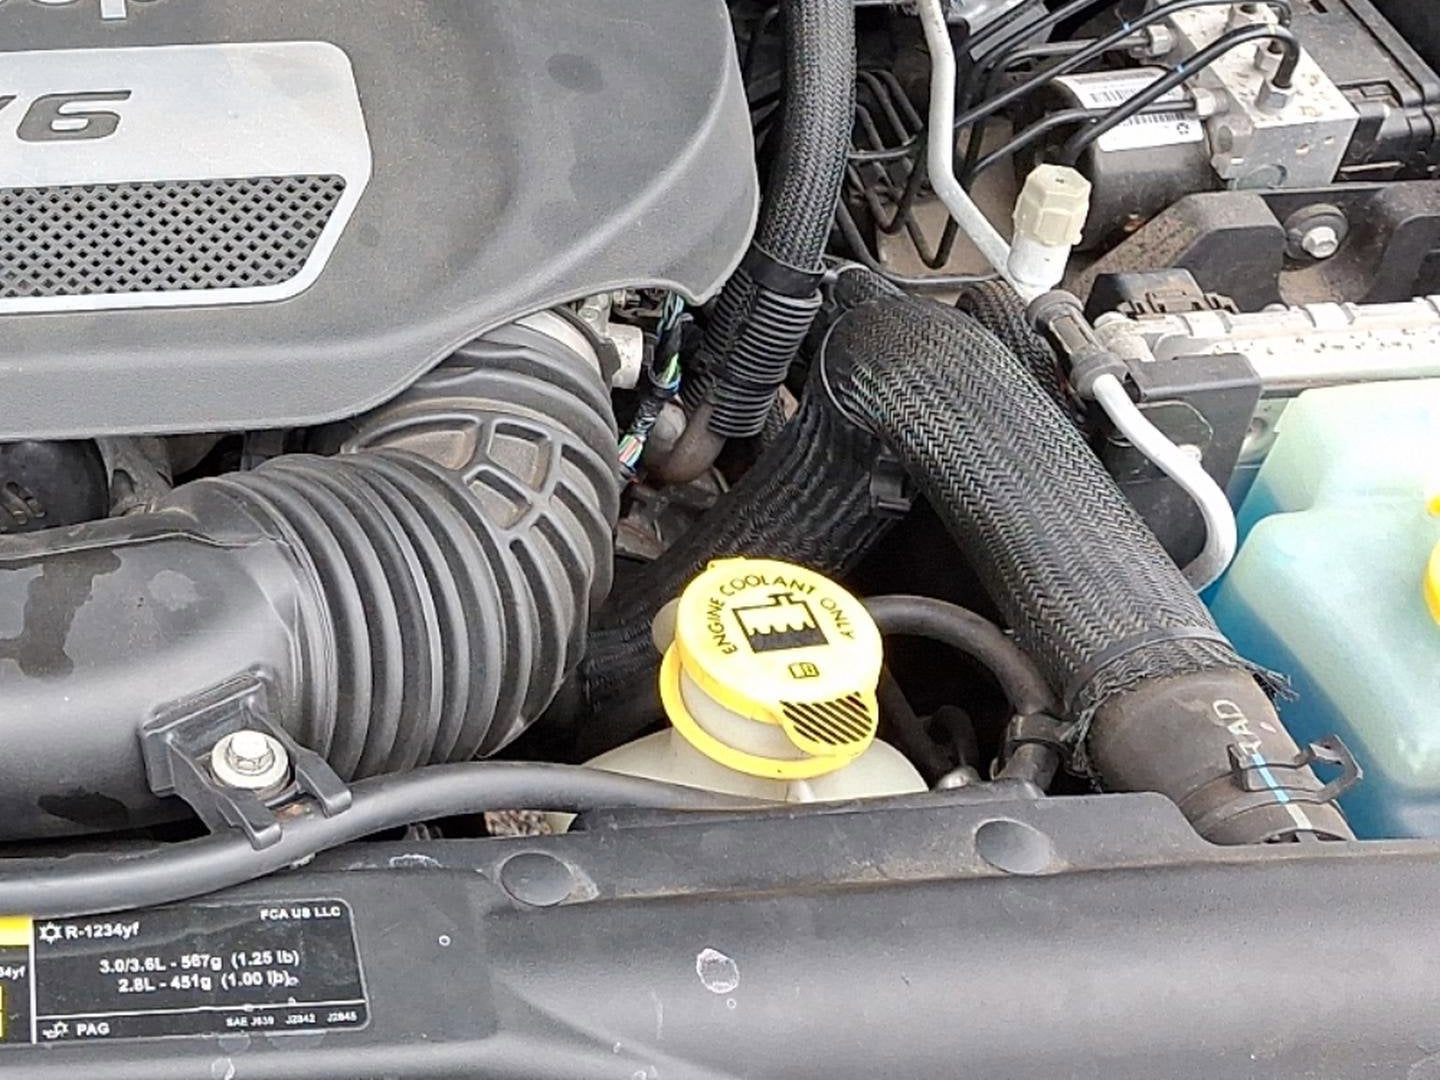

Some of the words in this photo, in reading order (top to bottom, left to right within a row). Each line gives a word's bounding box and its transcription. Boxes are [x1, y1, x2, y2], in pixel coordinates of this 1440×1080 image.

[719, 575, 817, 597] COOLANT
[707, 597, 738, 655] ENGINE
[819, 597, 856, 641] ONLY
[260, 908, 288, 920] FCA
[292, 908, 312, 919] US
[314, 906, 341, 918] LLC
[65, 922, 140, 941] R-1234yf
[98, 958, 166, 974] 3.0/3.6L
[181, 955, 222, 972] 567g
[231, 951, 273, 969] (1.25
[276, 949, 300, 967] lb)
[117, 978, 156, 994] 2.8L
[169, 974, 212, 991] 451g
[221, 972, 262, 990] (1.00
[266, 970, 291, 988] lb)
[76, 1023, 110, 1037] PAG
[226, 1017, 249, 1028] SAE
